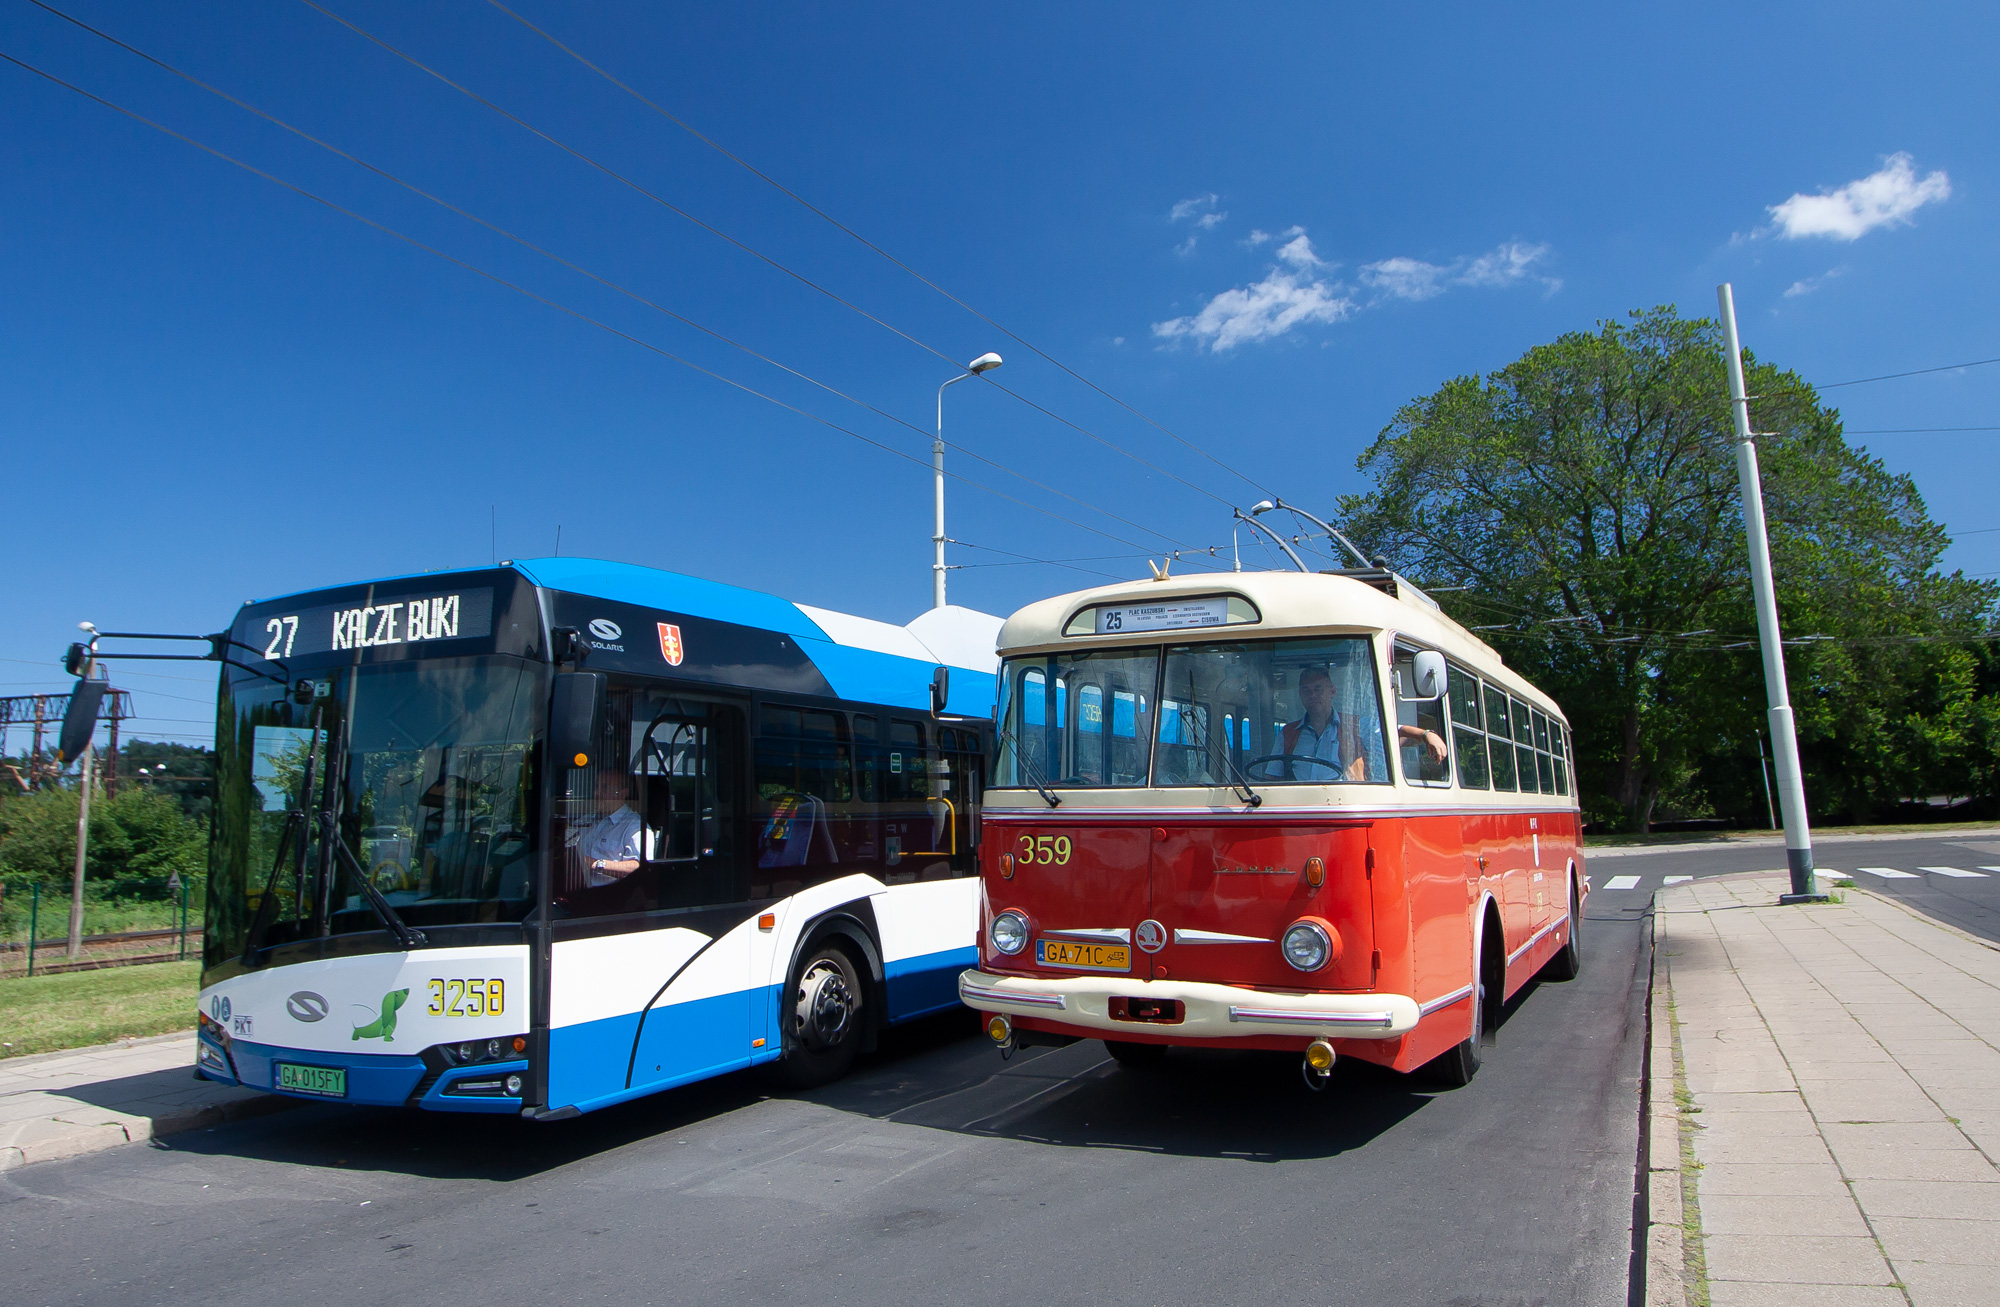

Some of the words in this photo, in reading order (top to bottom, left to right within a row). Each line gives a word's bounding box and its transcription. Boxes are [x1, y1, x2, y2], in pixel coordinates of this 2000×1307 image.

[1105, 611, 1122, 630] 25
[1128, 608, 1140, 616] PLAC
[1141, 607, 1166, 615] KASZUBSKI
[1201, 616, 1220, 624] CISOWA
[264, 615, 299, 660] 27
[331, 603, 403, 650] KACZE
[407, 595, 459, 641] BUKI
[591, 641, 625, 653] SOLARIS
[1018, 834, 1072, 866] 359
[1047, 943, 1069, 962] GA
[1074, 945, 1104, 965] 71C
[427, 978, 505, 1017] 3258
[235, 1019, 252, 1034] PKT
[282, 1066, 299, 1086] GA
[302, 1068, 342, 1091] 015FY
